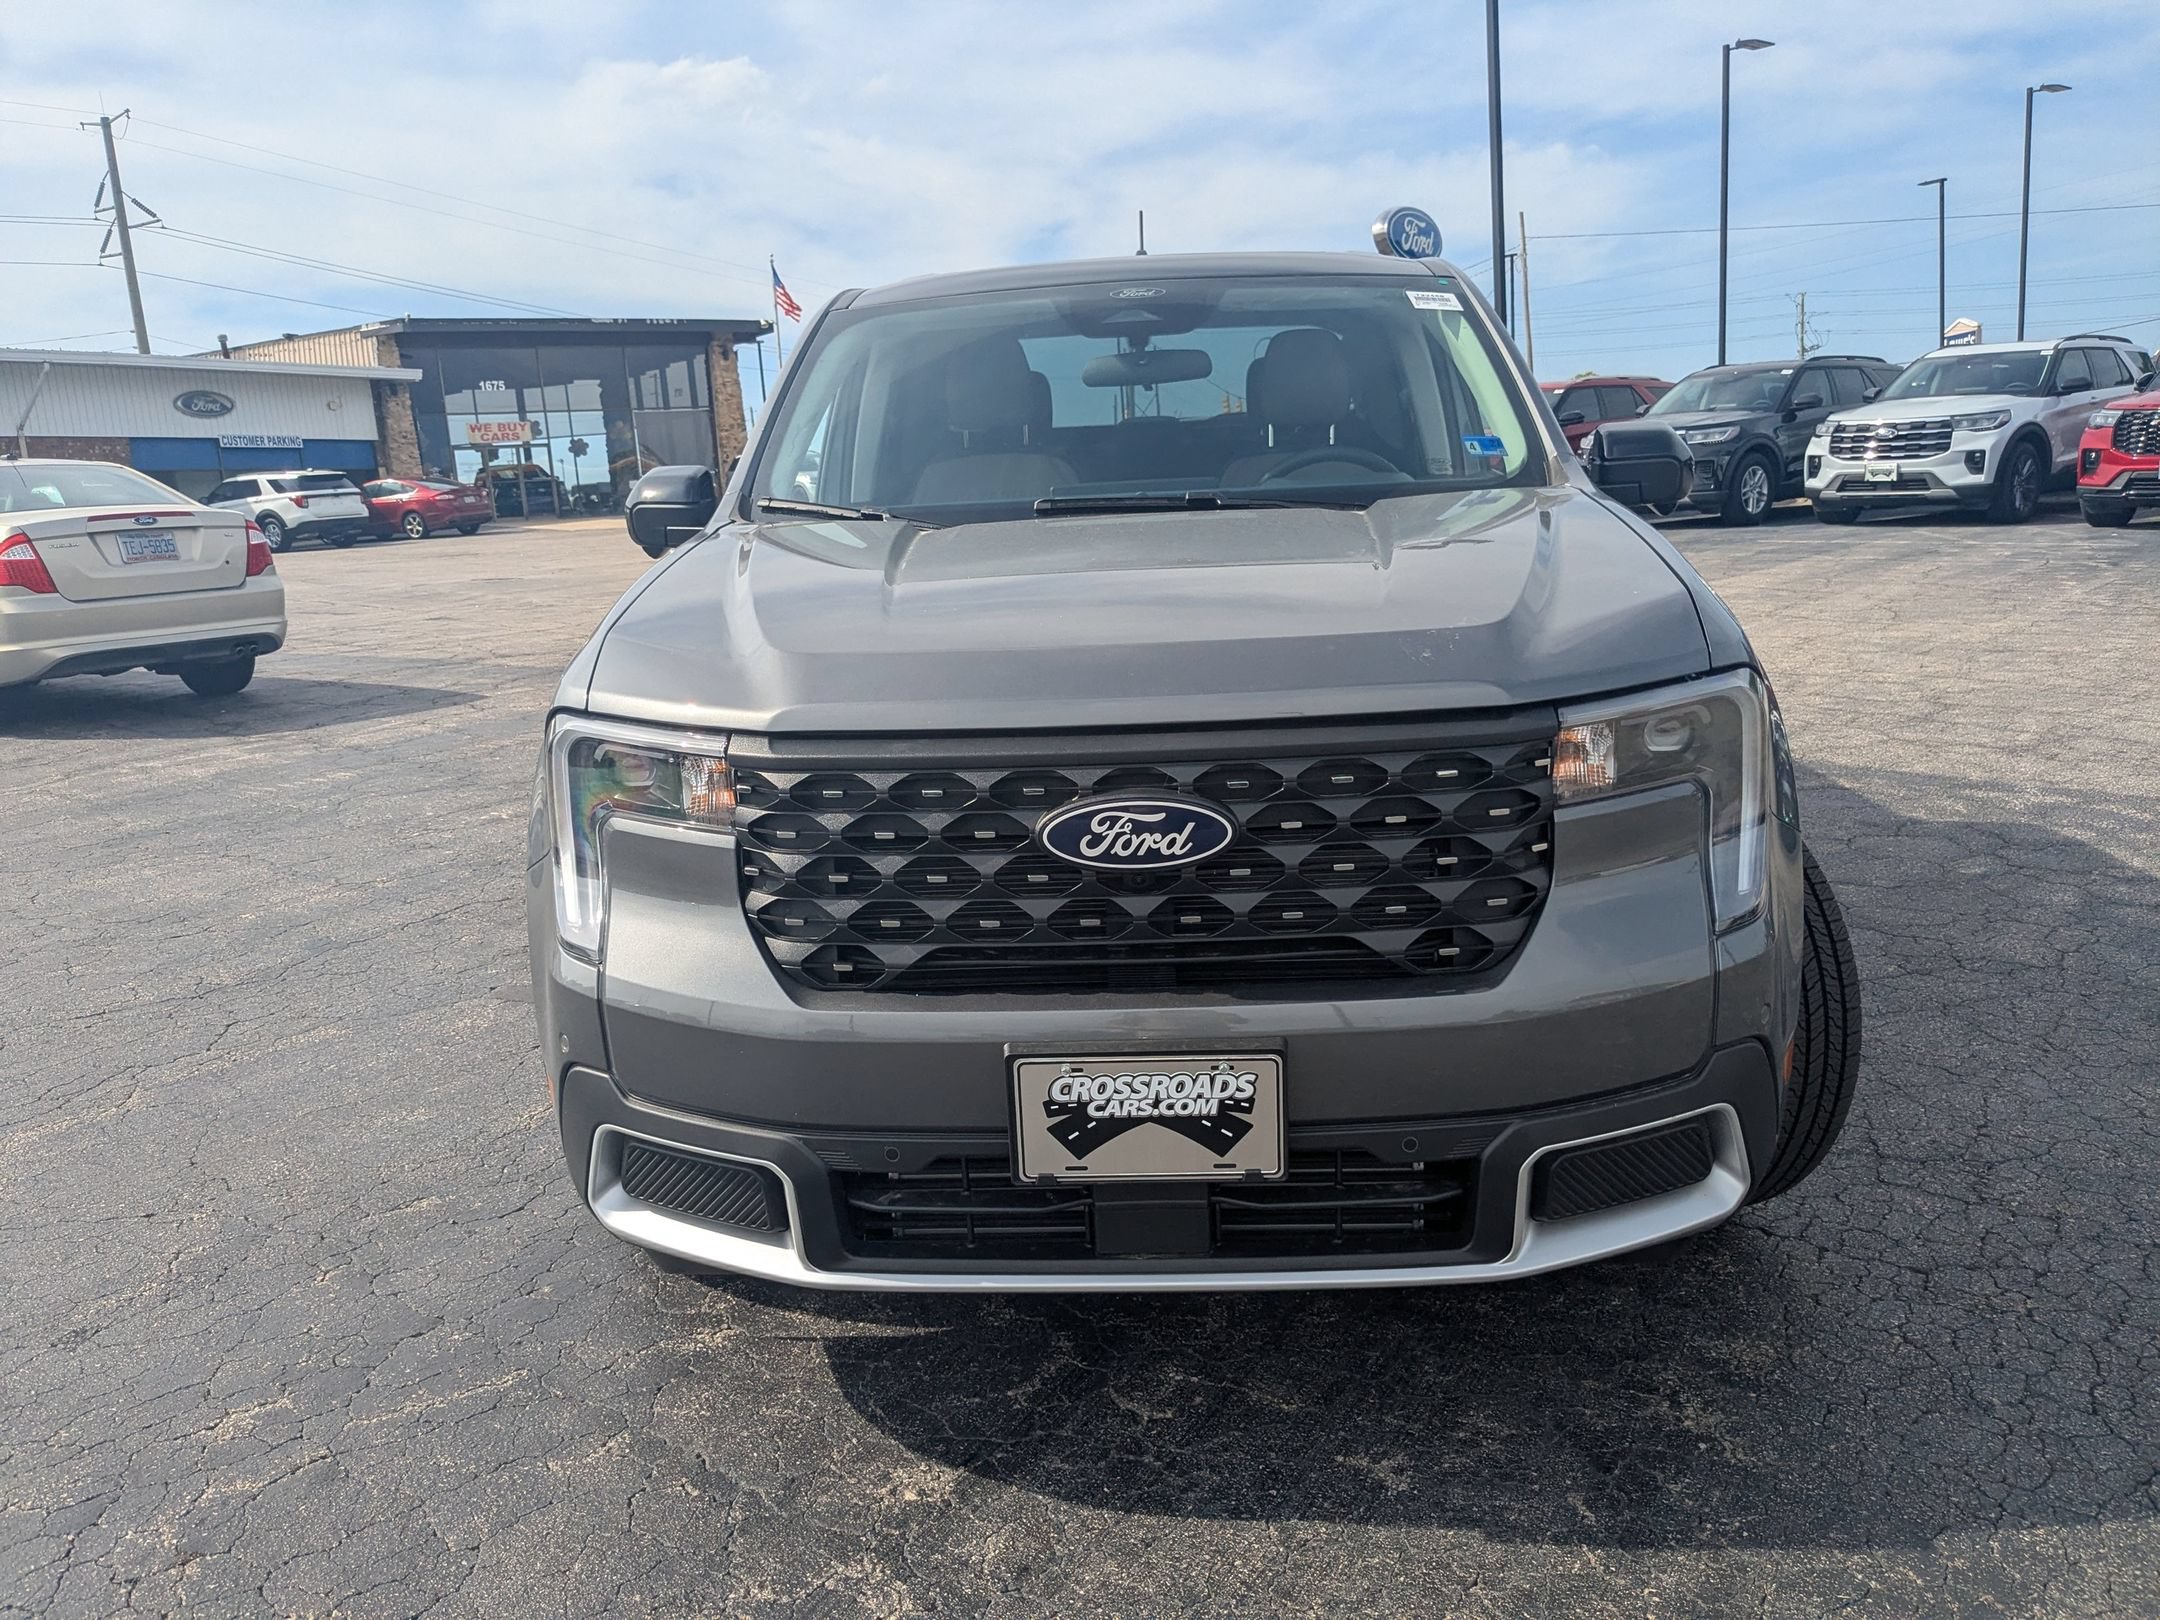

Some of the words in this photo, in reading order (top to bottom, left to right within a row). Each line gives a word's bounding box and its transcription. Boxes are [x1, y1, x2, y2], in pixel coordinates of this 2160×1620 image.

[1401, 217, 1434, 255] Ford
[479, 380, 506, 391] 1675
[469, 423, 492, 433] WE
[497, 422, 527, 432] BUY
[221, 435, 266, 447] CUSTOMER
[267, 436, 302, 447] PARKING
[480, 432, 520, 442] CARS
[122, 538, 176, 555] TEJ-5835
[1079, 811, 1196, 857] Ford
[1049, 1073, 1258, 1102] CROSSROADS
[1086, 1098, 1220, 1118] CARS.COM
